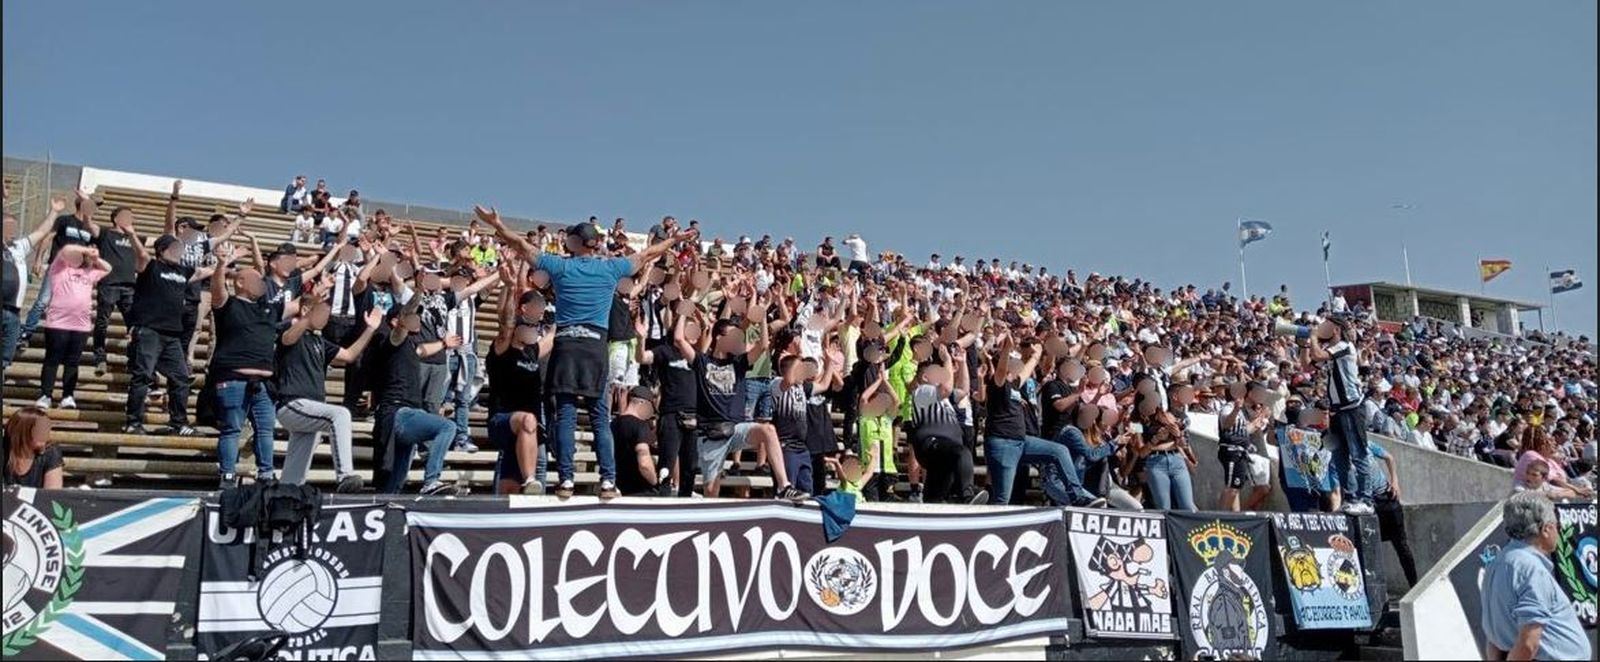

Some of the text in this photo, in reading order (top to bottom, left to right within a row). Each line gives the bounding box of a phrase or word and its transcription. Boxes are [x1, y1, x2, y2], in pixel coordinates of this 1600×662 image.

[1070, 512, 1162, 538] BALONA
[17, 507, 60, 588] LINENSE
[424, 527, 1053, 645] COLECTIVO DOCE
[1092, 610, 1172, 633] NADA MAS
[1192, 594, 1203, 631] REAL
